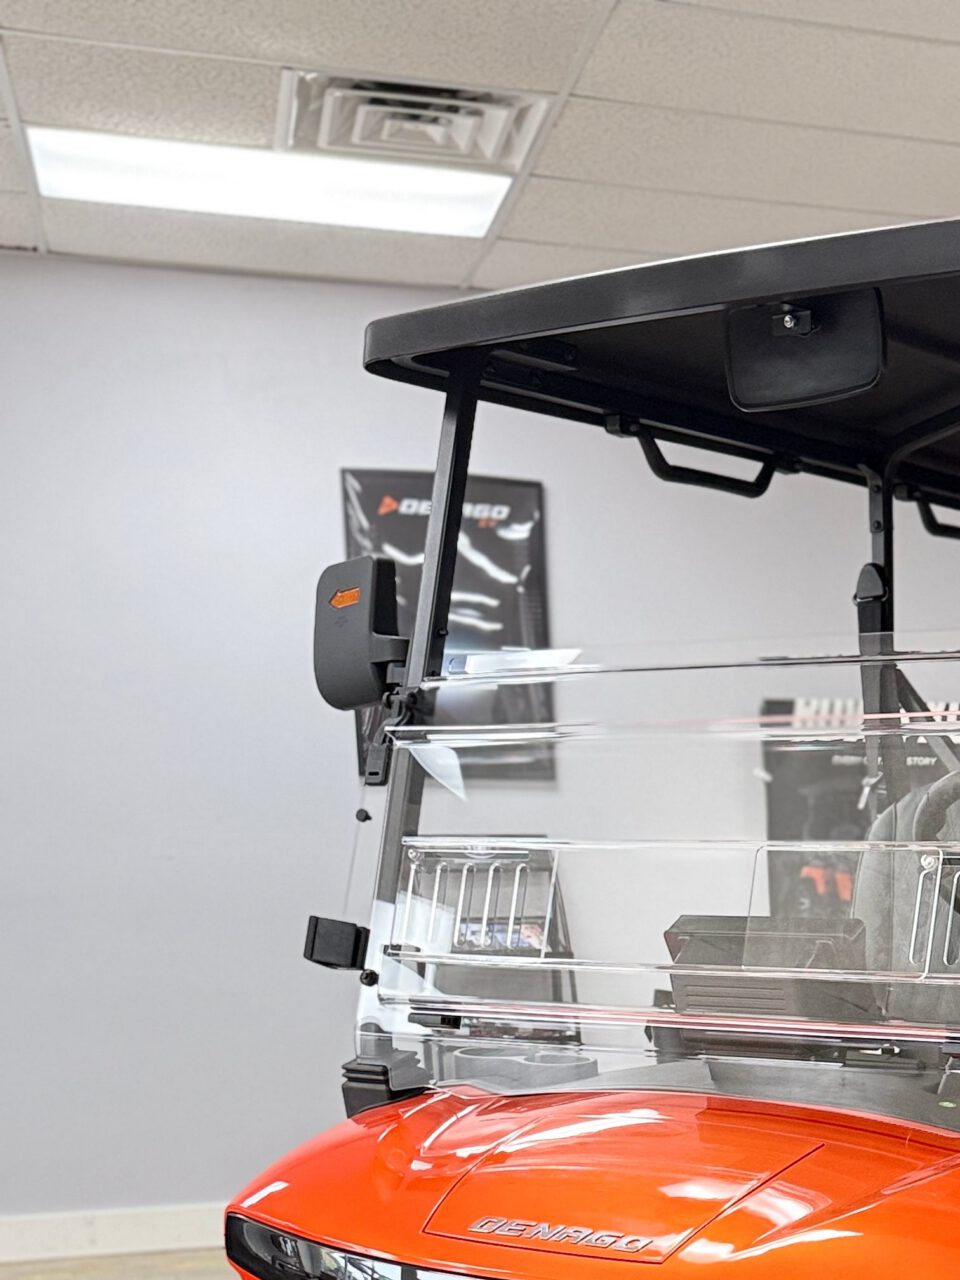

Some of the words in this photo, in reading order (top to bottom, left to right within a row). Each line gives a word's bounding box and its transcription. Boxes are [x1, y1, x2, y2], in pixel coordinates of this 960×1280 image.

[398, 498, 510, 521] DEAGO
[906, 756, 937, 766] STORY
[467, 1216, 654, 1253] DENAGO
